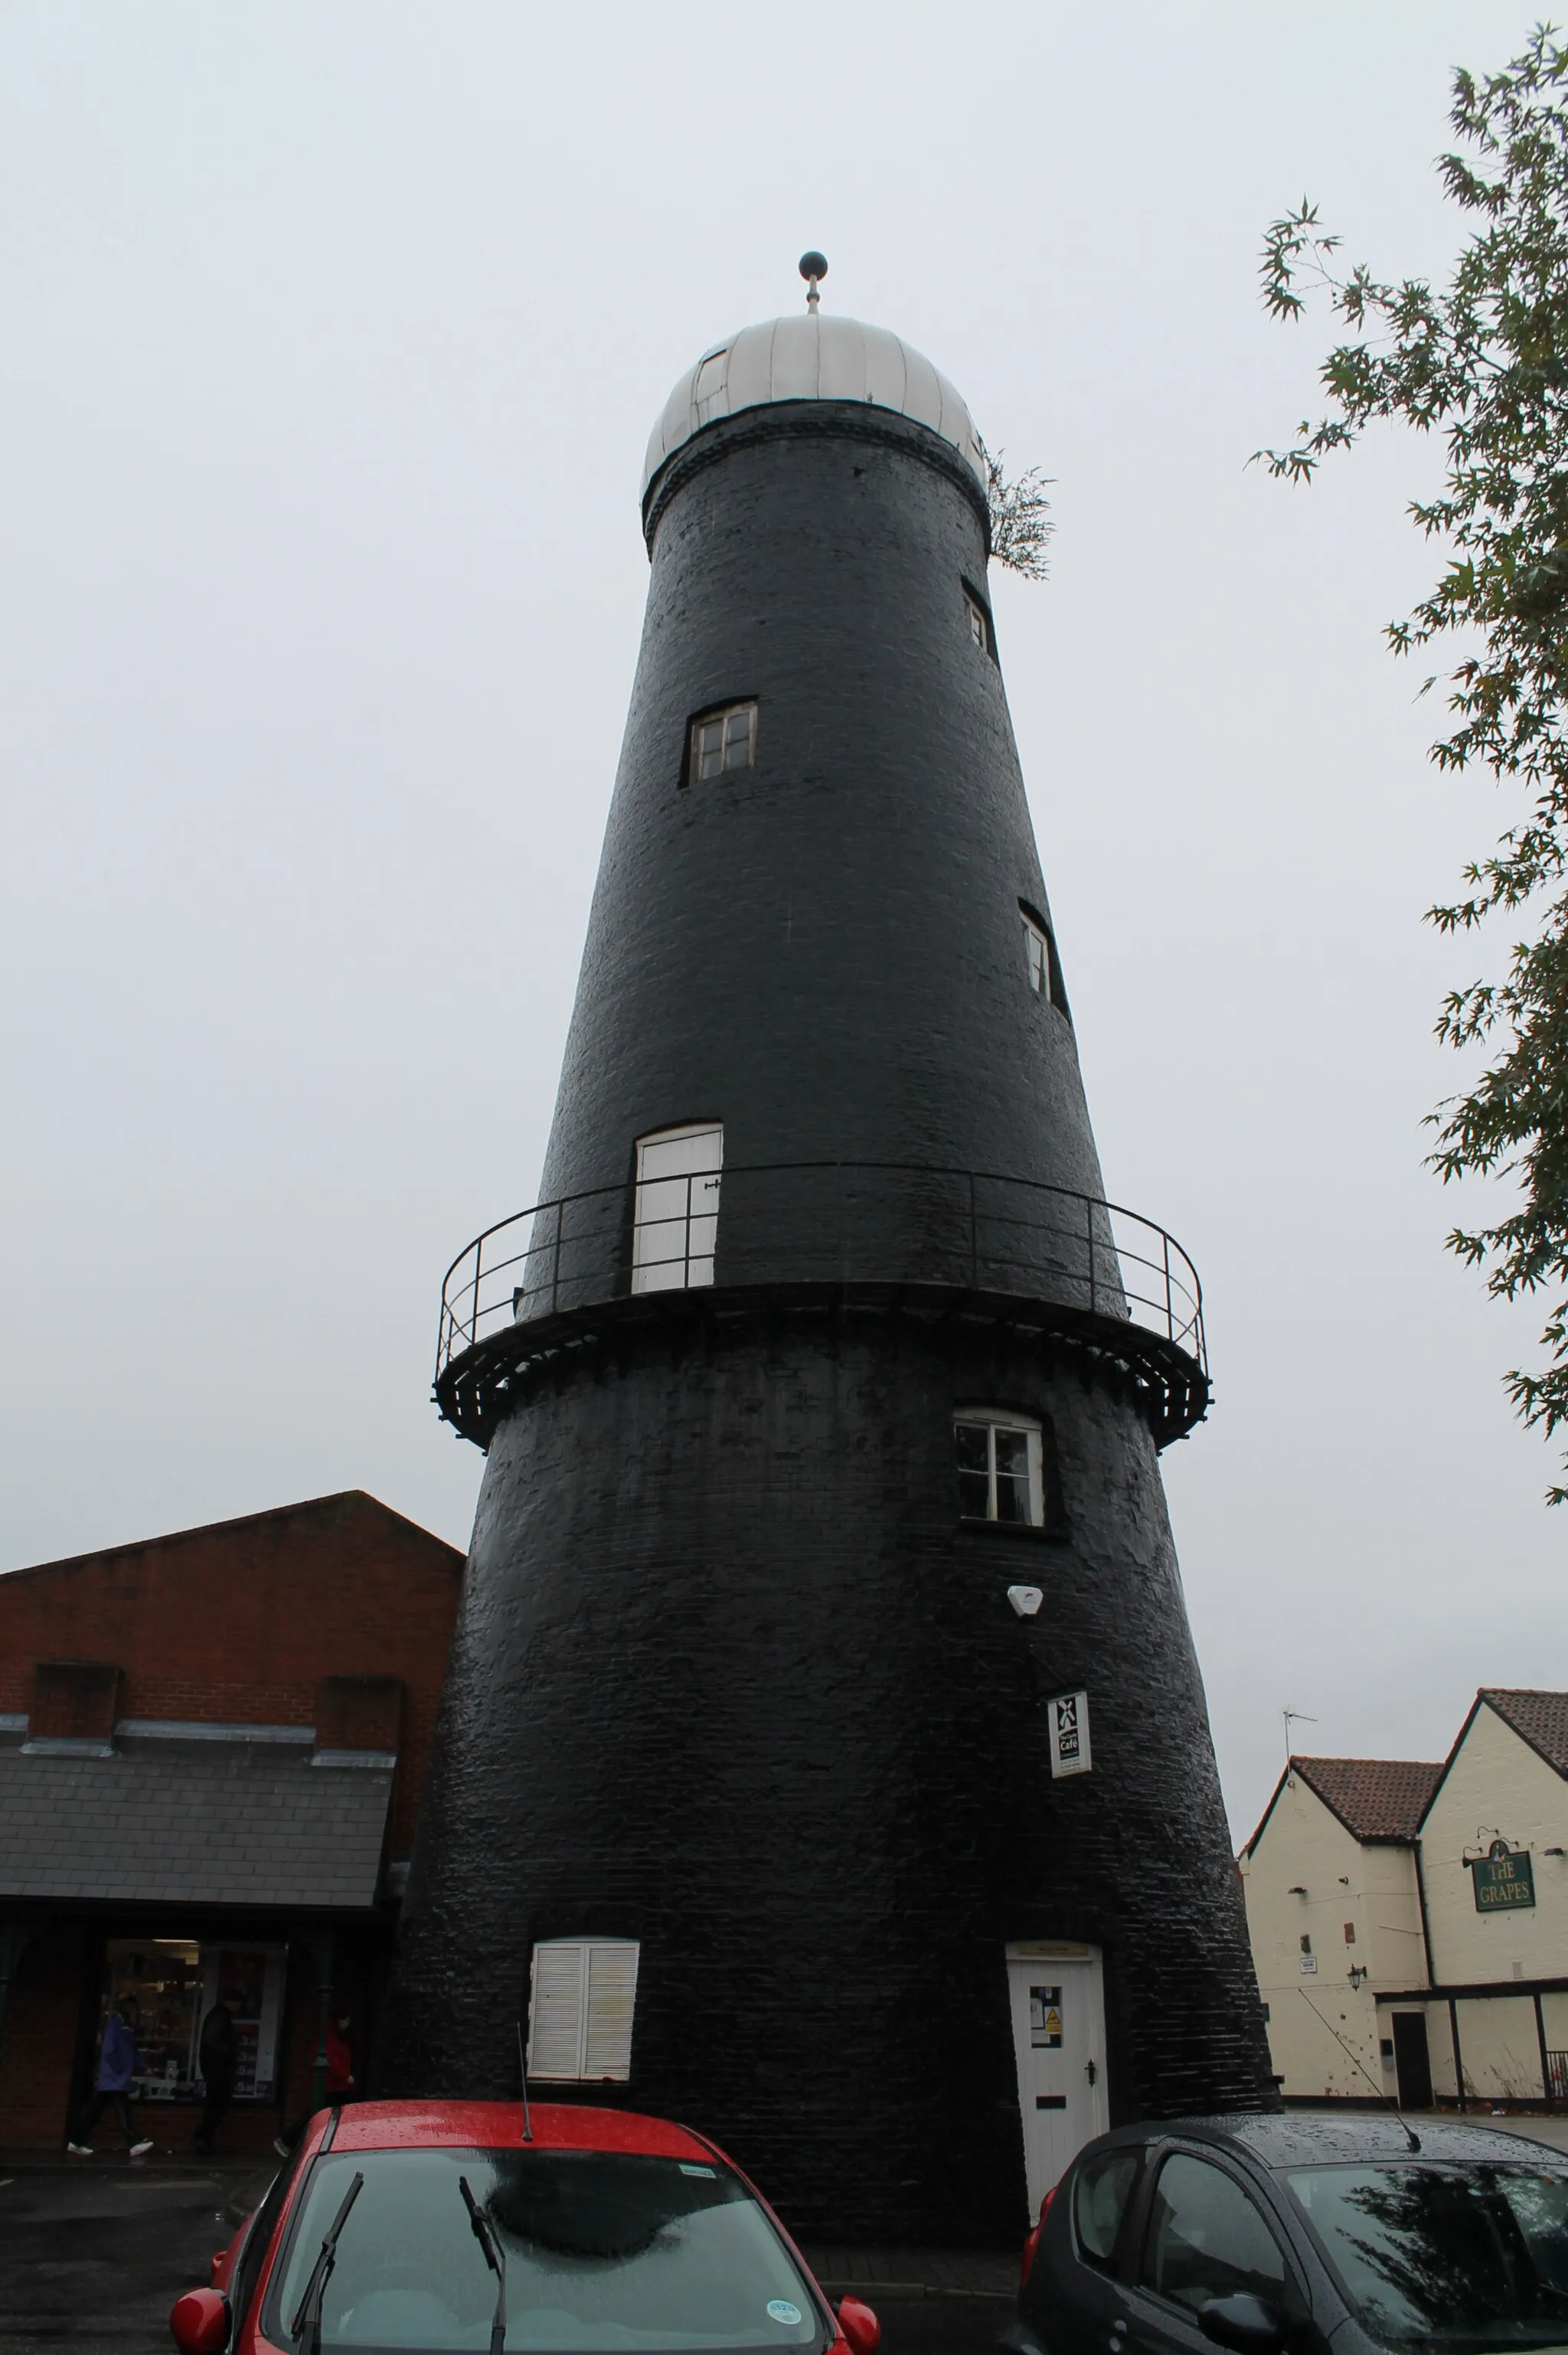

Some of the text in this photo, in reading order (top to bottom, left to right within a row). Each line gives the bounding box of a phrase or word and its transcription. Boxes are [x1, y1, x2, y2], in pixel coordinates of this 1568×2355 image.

[1060, 1738, 1077, 1750] Café
[1488, 1862, 1515, 1880] THE
[1480, 1882, 1530, 1903] GRAPES
